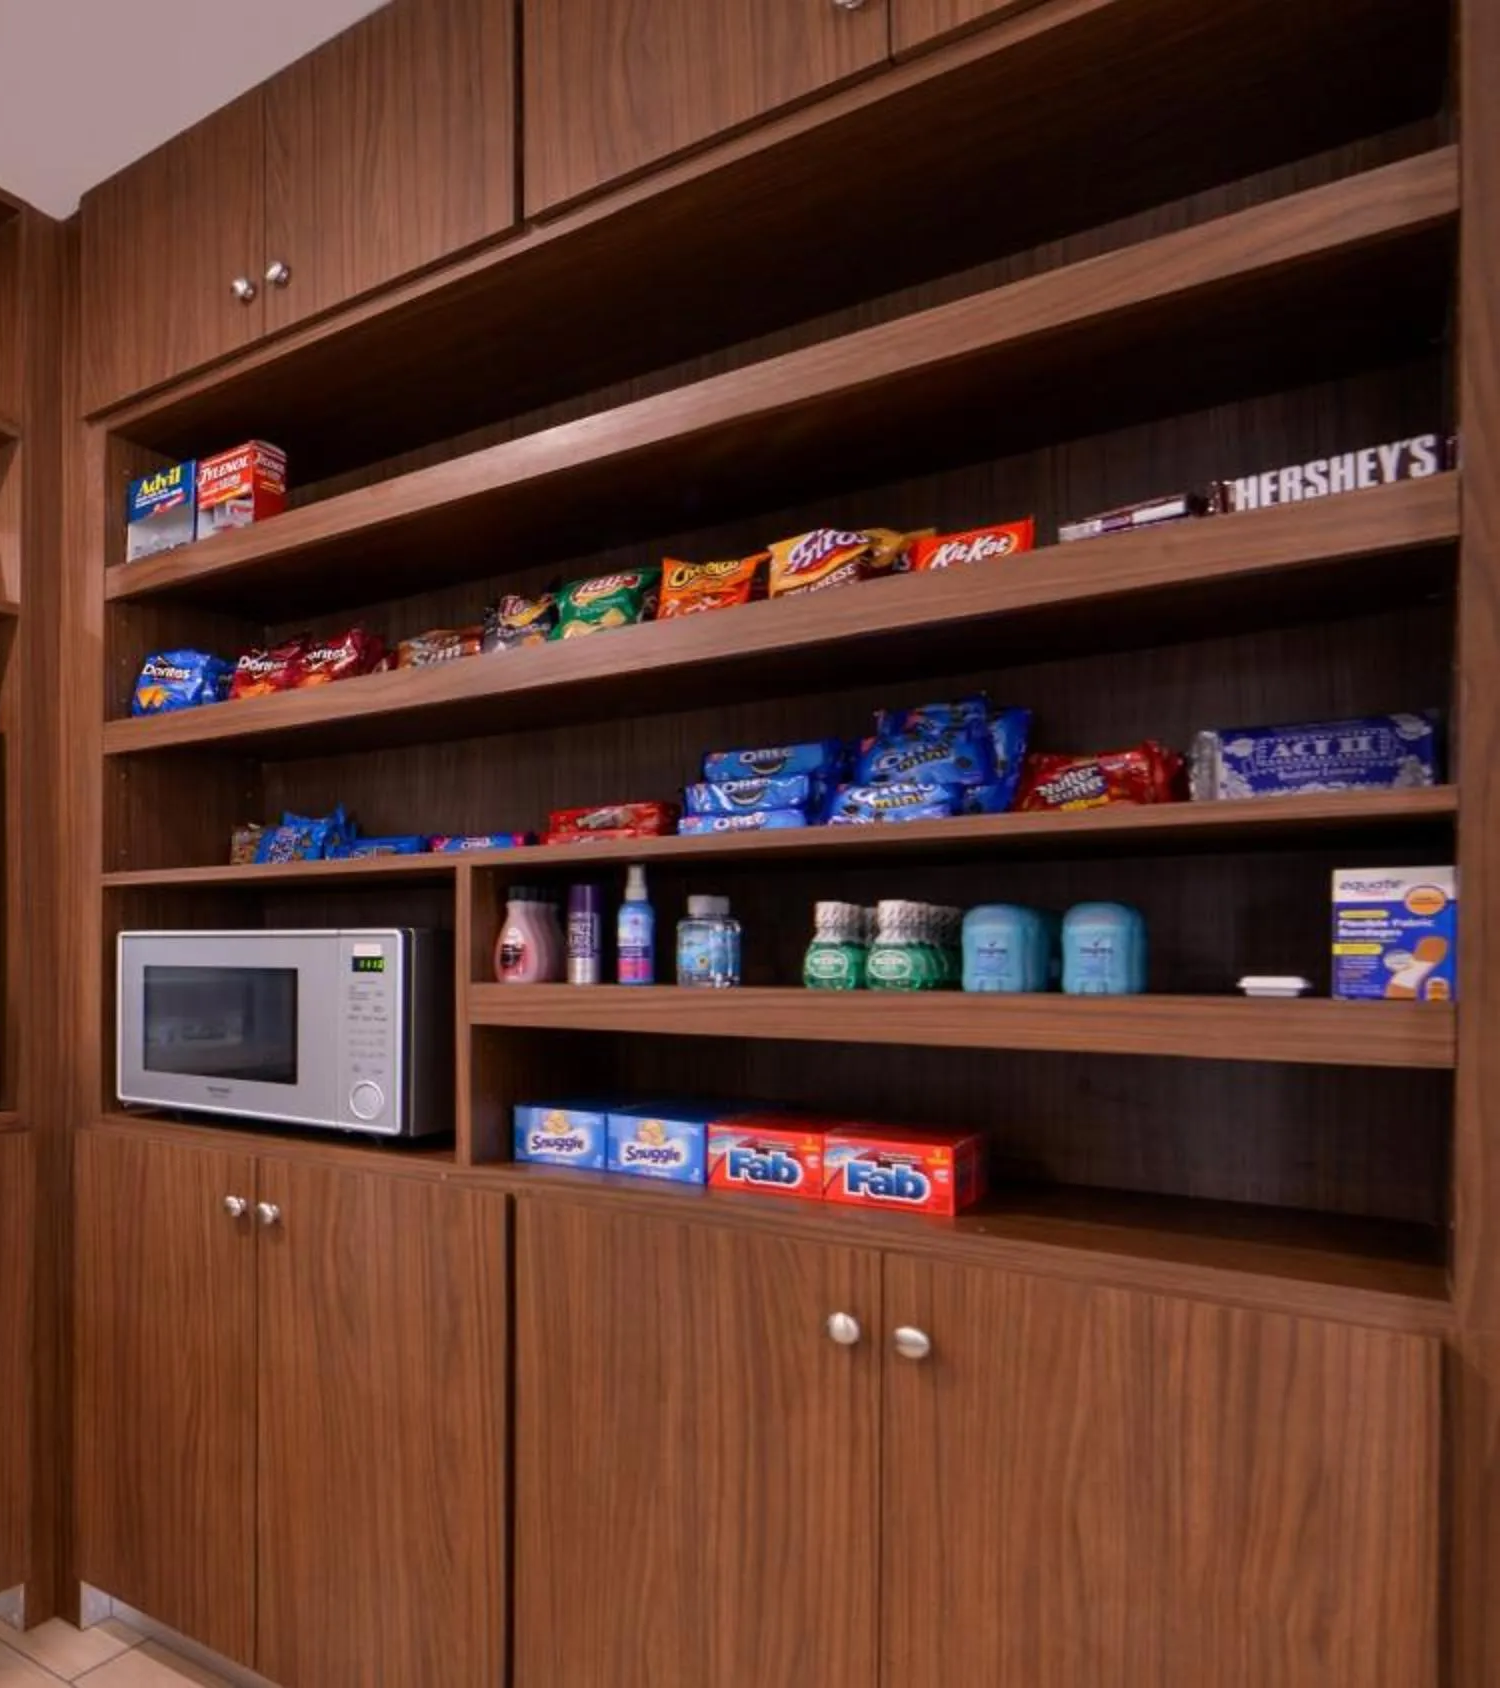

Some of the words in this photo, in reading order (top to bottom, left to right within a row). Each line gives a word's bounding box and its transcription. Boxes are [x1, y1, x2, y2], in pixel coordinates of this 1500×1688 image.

[137, 465, 181, 497] Advil
[1234, 433, 1438, 513] HERSHEY'S
[784, 529, 869, 576] Fritos
[142, 663, 191, 680] Doritos
[1272, 739, 1328, 757] ACT
[531, 1134, 584, 1152] Snuggle
[625, 1145, 681, 1164] Snuggle
[726, 1148, 803, 1187] Fab
[844, 1160, 931, 1204] Fab
